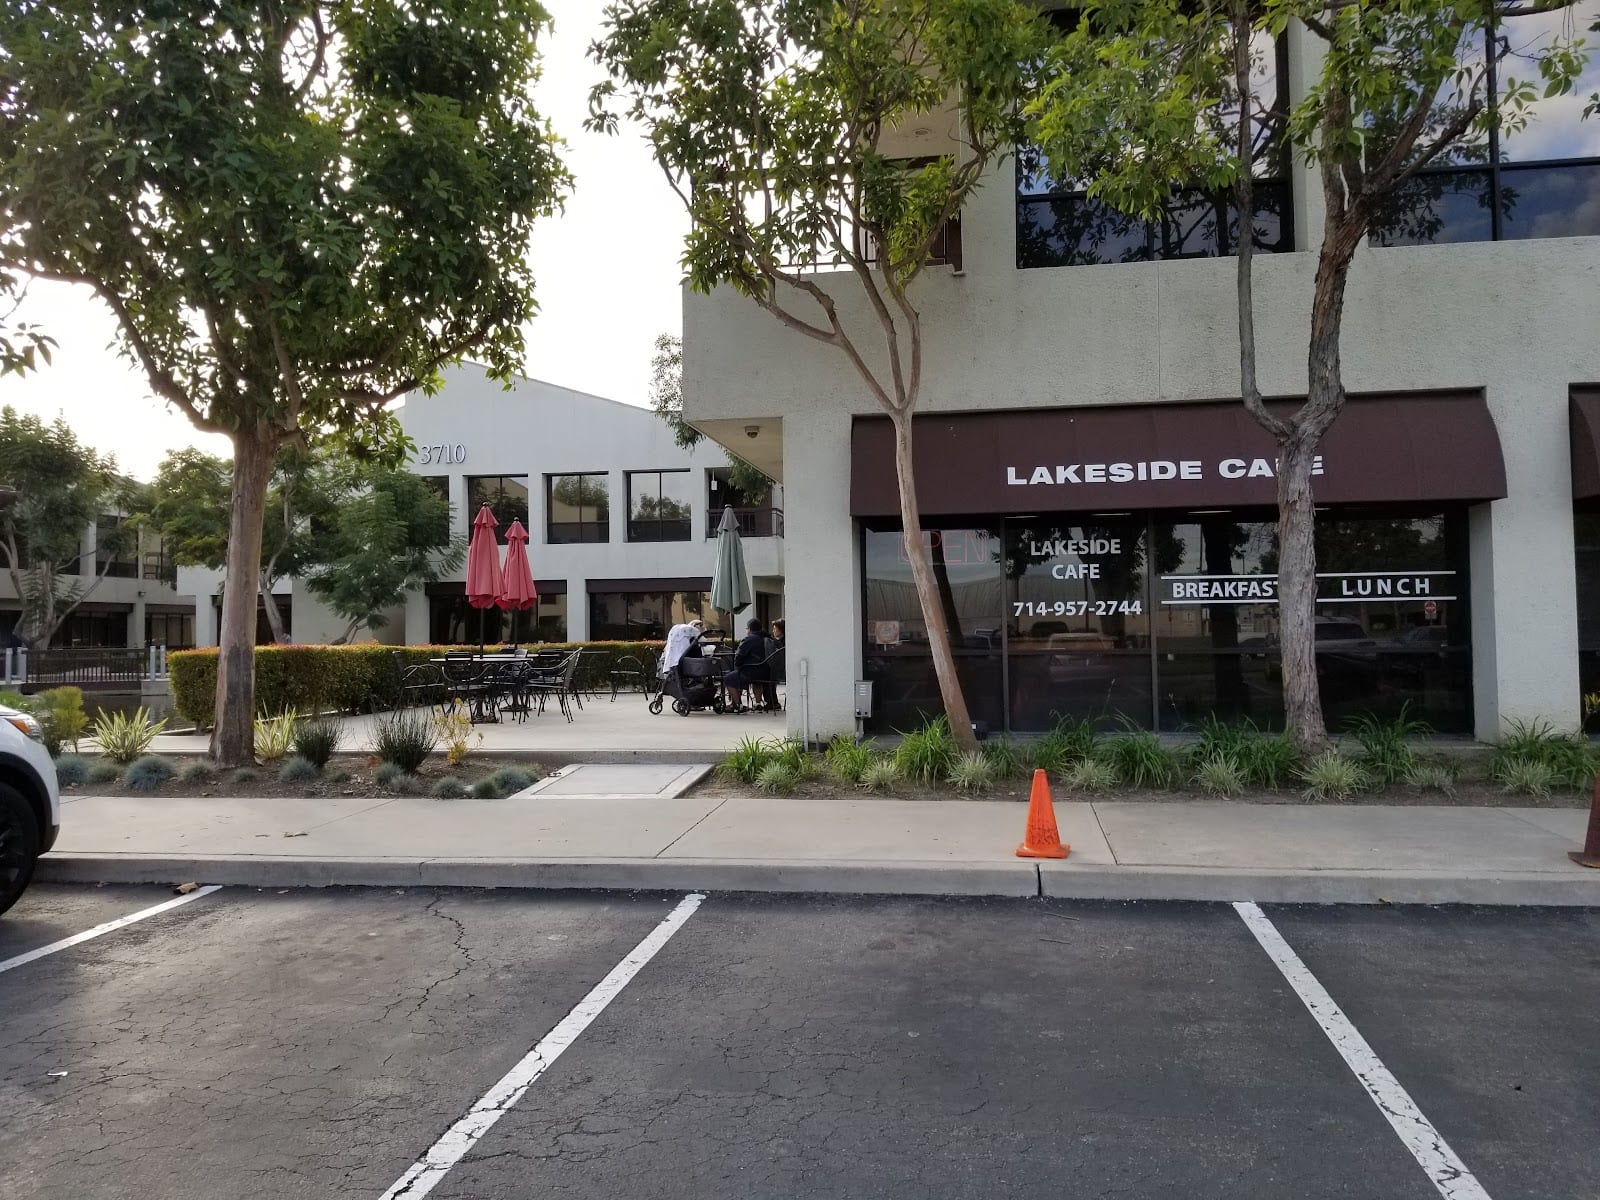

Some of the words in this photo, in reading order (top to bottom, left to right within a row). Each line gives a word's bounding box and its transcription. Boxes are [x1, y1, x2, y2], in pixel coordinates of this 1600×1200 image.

[420, 443, 466, 464] 3710
[1006, 460, 1203, 485] LAKESIDE
[1218, 455, 1325, 479] CAE
[1030, 539, 1121, 556] LAKESIDE
[1051, 563, 1101, 580] CAFE
[1341, 578, 1430, 596] LUNCH
[1013, 600, 1143, 617] 714-957-2744
